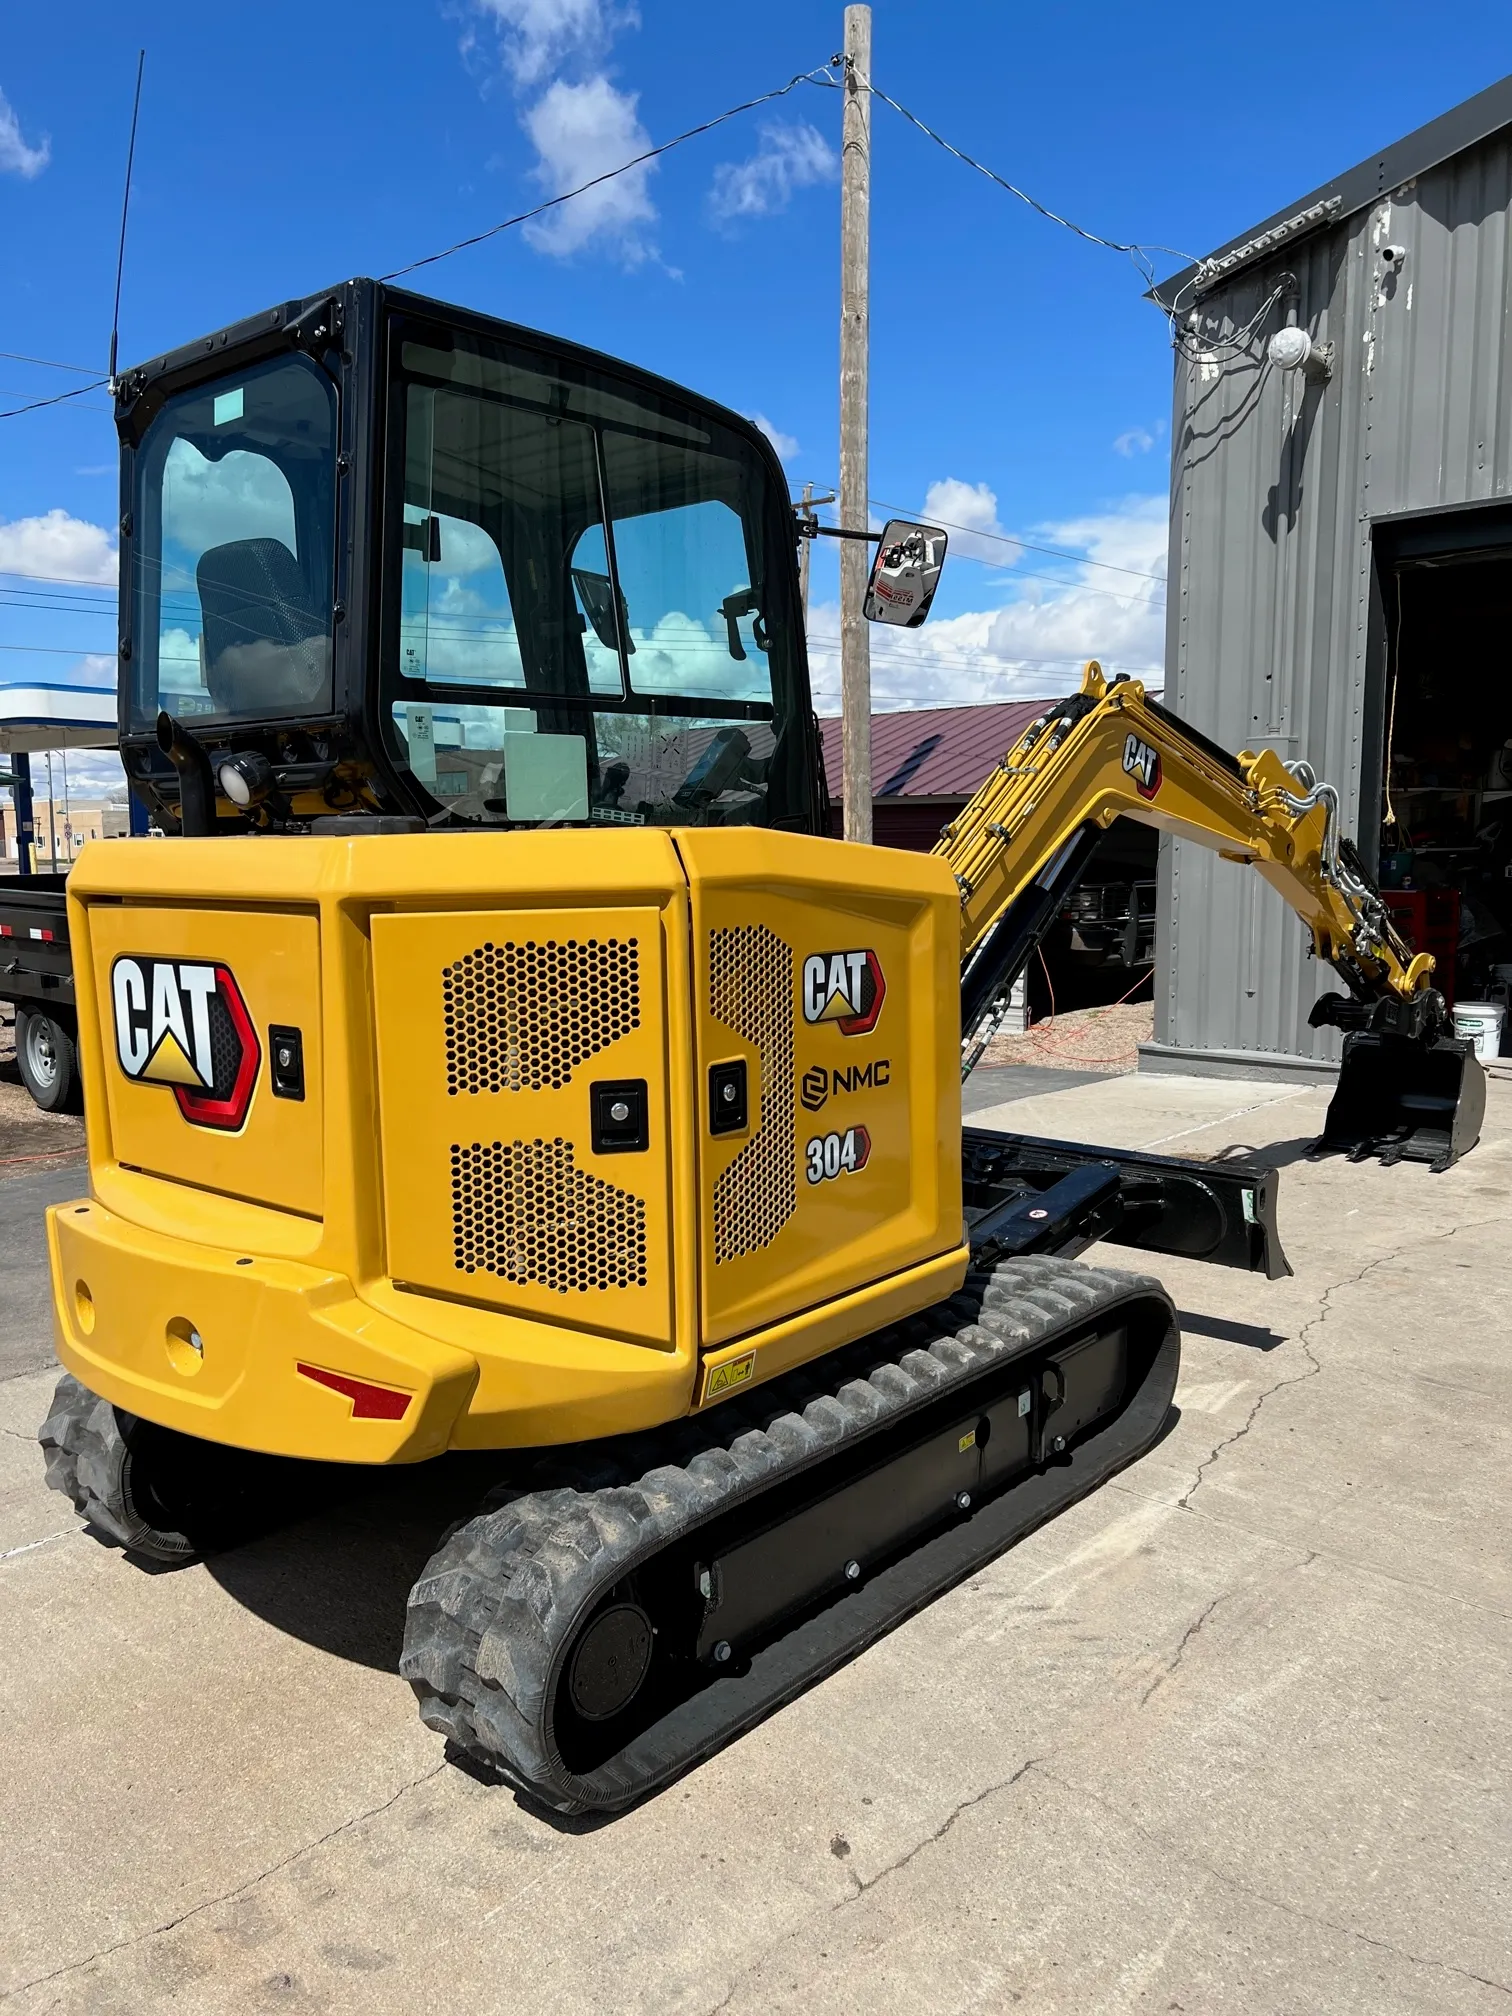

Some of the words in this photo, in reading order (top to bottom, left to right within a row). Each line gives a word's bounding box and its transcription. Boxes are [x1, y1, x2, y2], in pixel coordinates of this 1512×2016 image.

[1123, 733, 1157, 786] CAT
[803, 952, 867, 1022] CAT
[113, 958, 217, 1088] CAT
[832, 1059, 890, 1096] NMC
[807, 1129, 857, 1183] 304
